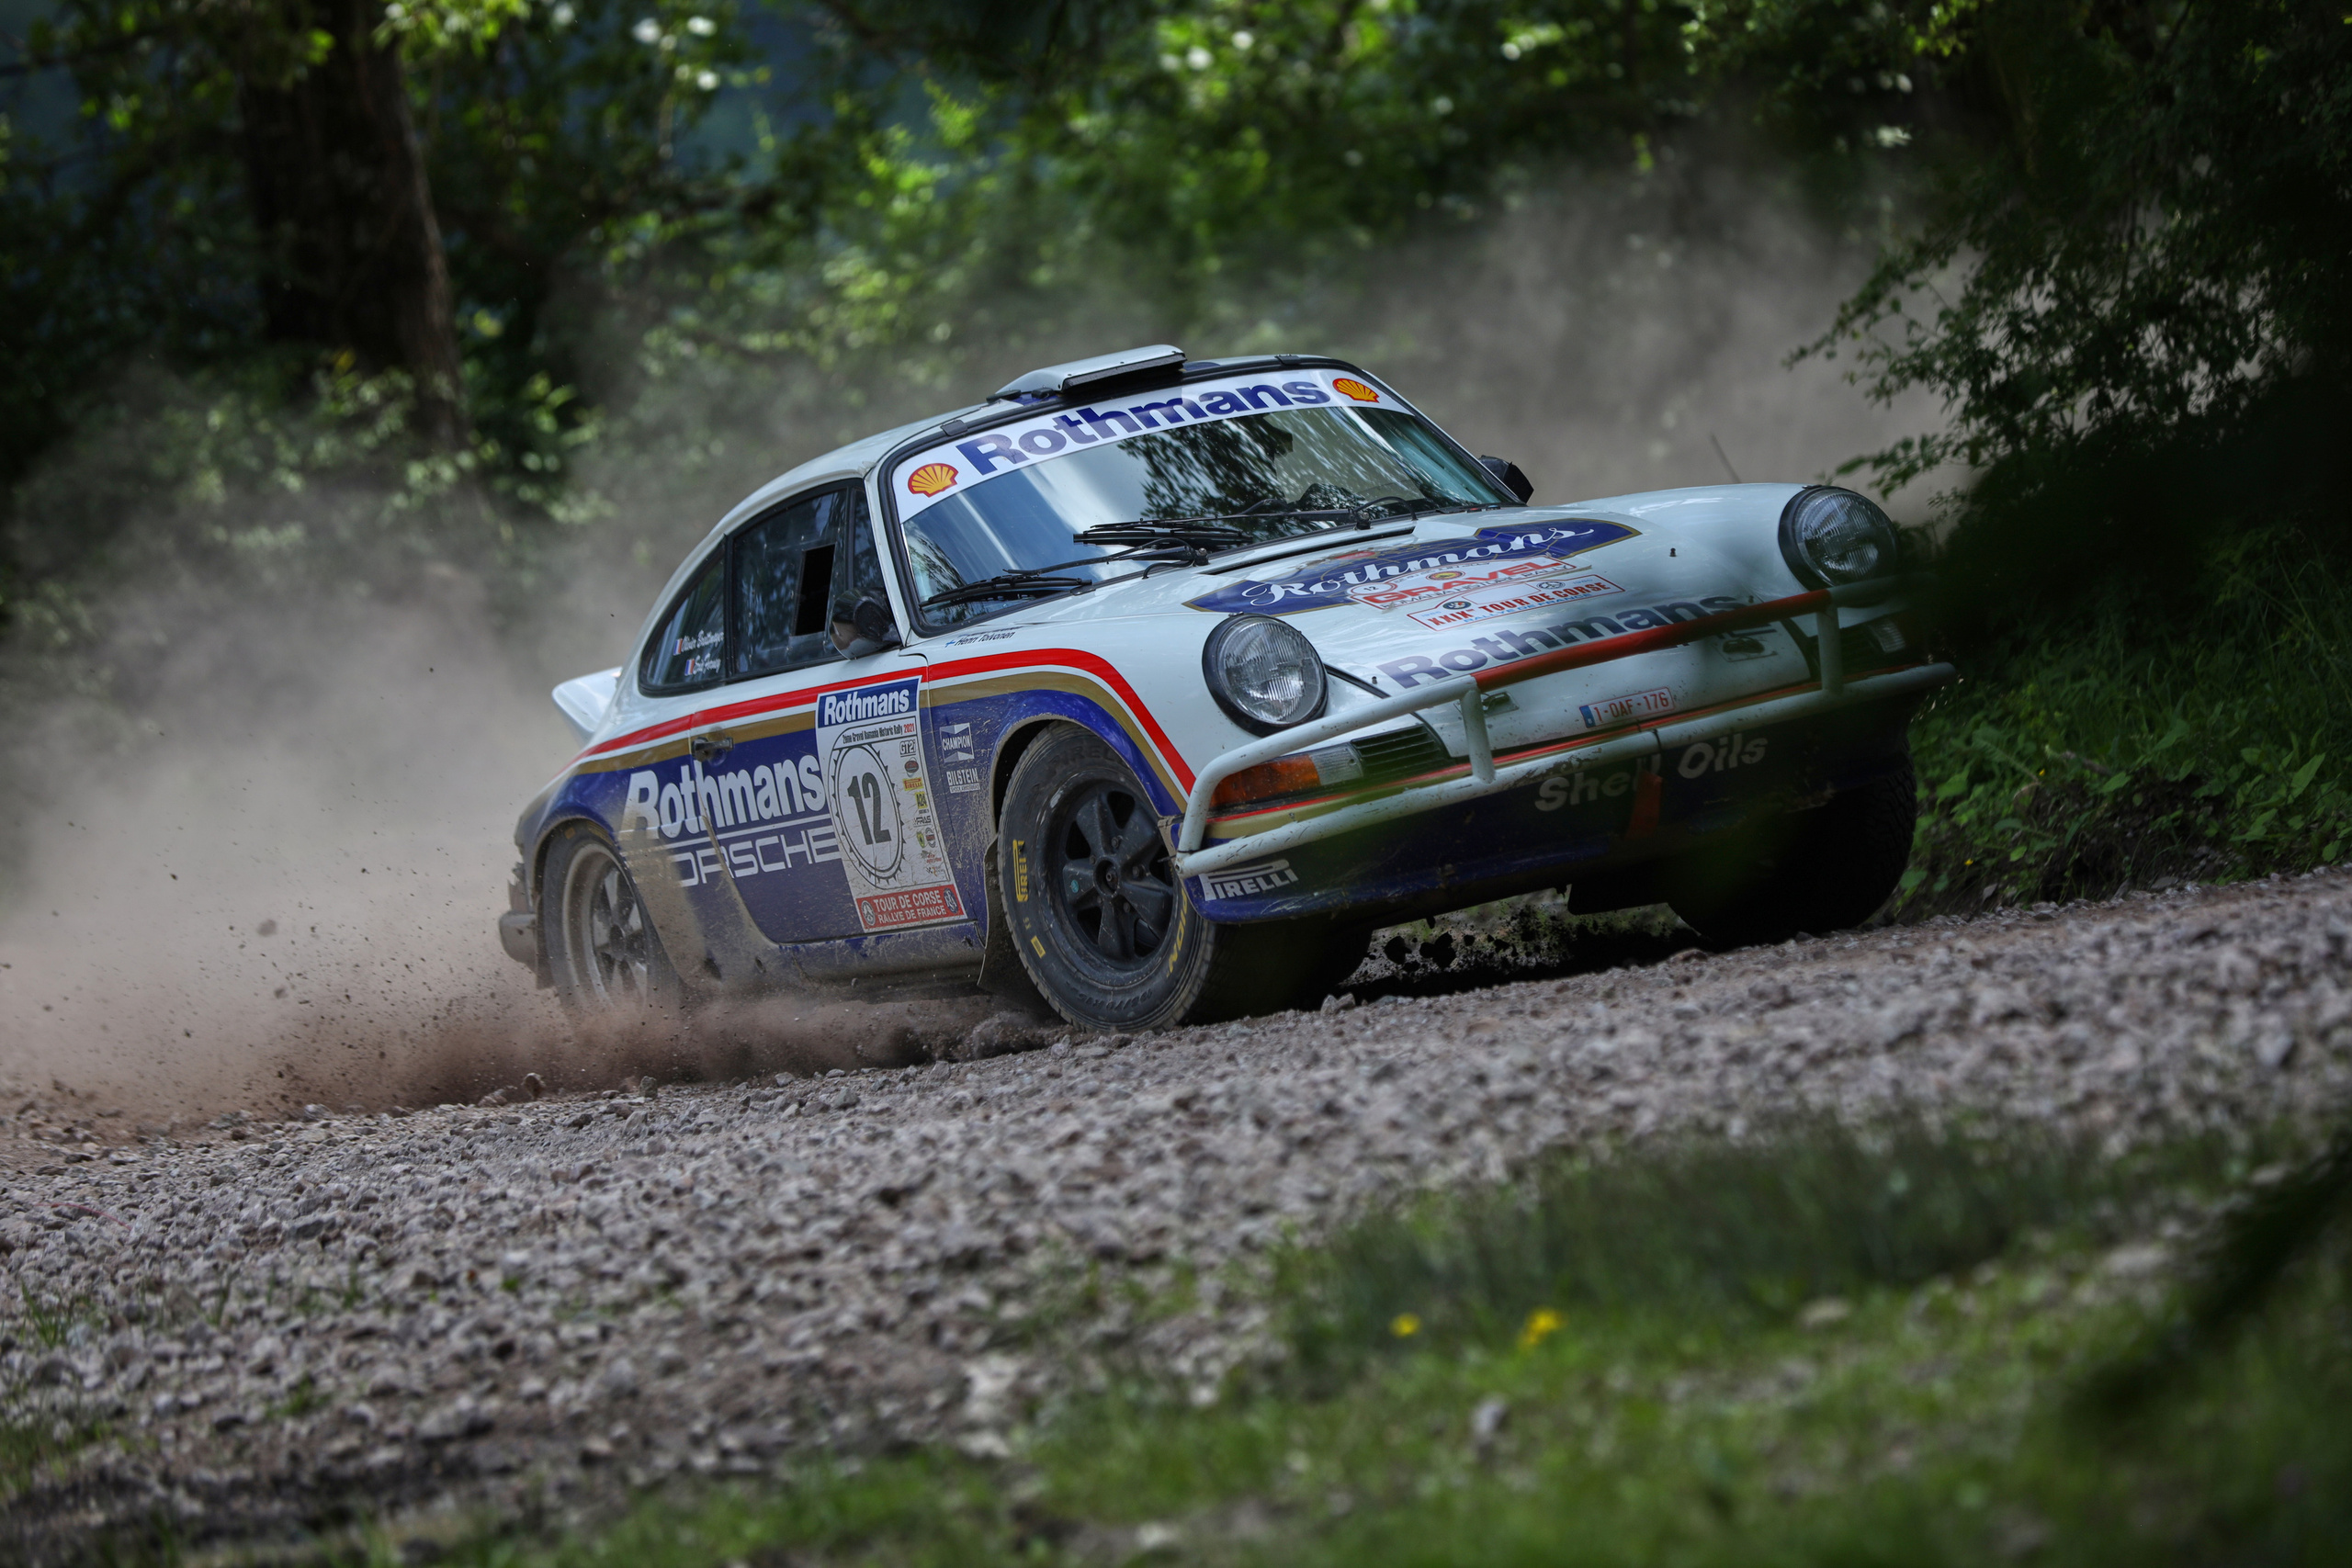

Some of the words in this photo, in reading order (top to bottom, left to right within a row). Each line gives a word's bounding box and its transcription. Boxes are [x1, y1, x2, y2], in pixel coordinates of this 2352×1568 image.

[956, 381, 1331, 475] Rothmans
[1242, 527, 1594, 606] Rothmans
[1363, 561, 1563, 604] GRAVEL
[1521, 564, 1569, 578] RALLY
[1463, 608, 1515, 623] RALLYE
[1537, 592, 1591, 606] FRANCE
[1478, 596, 1531, 614] TOUR
[1529, 591, 1555, 604] DE
[1551, 580, 1611, 599] CORSE
[824, 688, 910, 726] Rothmans
[904, 723, 915, 734] 2021
[942, 735, 971, 751] CHAMPION
[1677, 733, 1769, 780] Oils
[946, 768, 979, 786] BILSTEIN
[618, 754, 826, 840] Rothmans
[847, 772, 891, 845] 12
[670, 825, 842, 888] ORSCHE
[1199, 858, 1299, 901] PIRELLI
[874, 897, 899, 912] TOUR
[898, 894, 912, 909] DE
[912, 890, 943, 907] CORSE
[877, 910, 905, 924] RALLYE
[906, 909, 917, 920] DE
[916, 905, 947, 919] FRANCE
